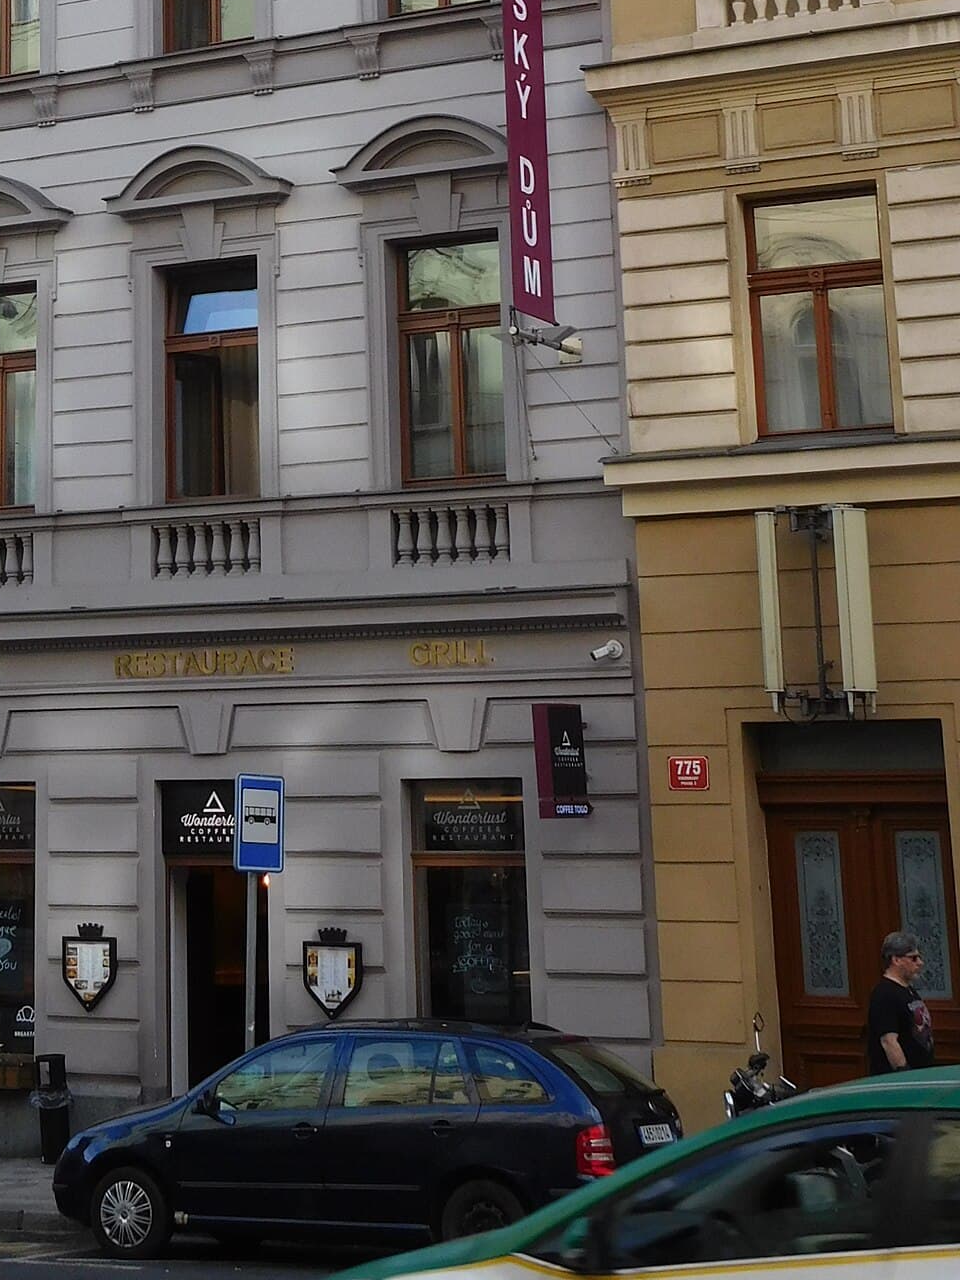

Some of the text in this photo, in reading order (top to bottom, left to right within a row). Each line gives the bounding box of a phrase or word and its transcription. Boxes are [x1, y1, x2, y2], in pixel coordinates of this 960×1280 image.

[519, 155, 542, 297] DŮM
[113, 646, 296, 678] RESTAURACE
[675, 760, 701, 775] 775
[433, 811, 507, 824] Wonderlust
